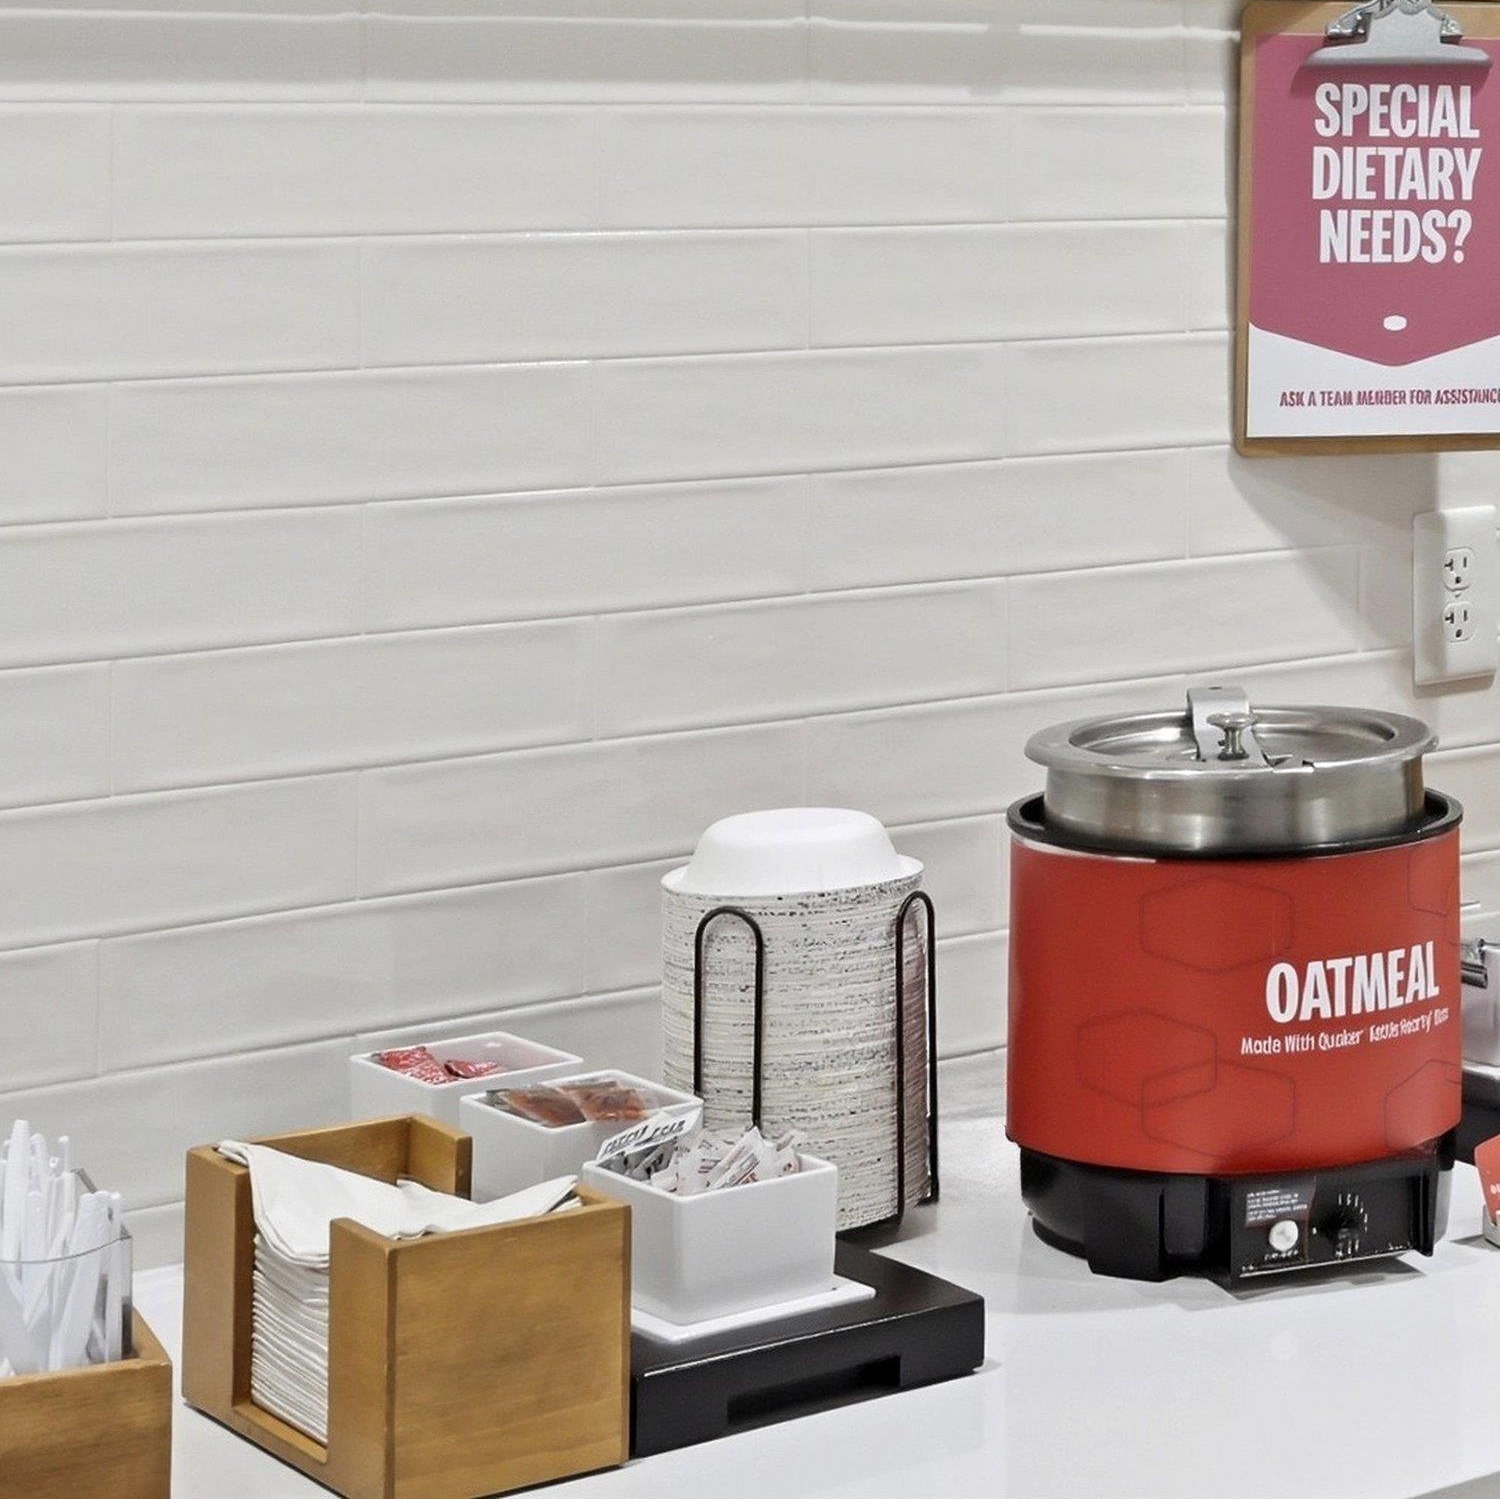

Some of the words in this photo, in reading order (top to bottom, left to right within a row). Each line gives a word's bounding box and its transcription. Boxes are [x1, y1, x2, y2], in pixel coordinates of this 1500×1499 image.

[1314, 82, 1480, 139] SPECIAL
[1312, 146, 1482, 200] DIETARY
[1319, 209, 1473, 264] NEEDS?
[1279, 390, 1305, 407] ASK
[1307, 390, 1317, 407] A
[1320, 390, 1354, 407] TEAM
[1410, 389, 1432, 405] FOR
[1266, 941, 1440, 1023] OATMEAL
[1241, 1035, 1281, 1055] Made
[1284, 1033, 1315, 1053] With
